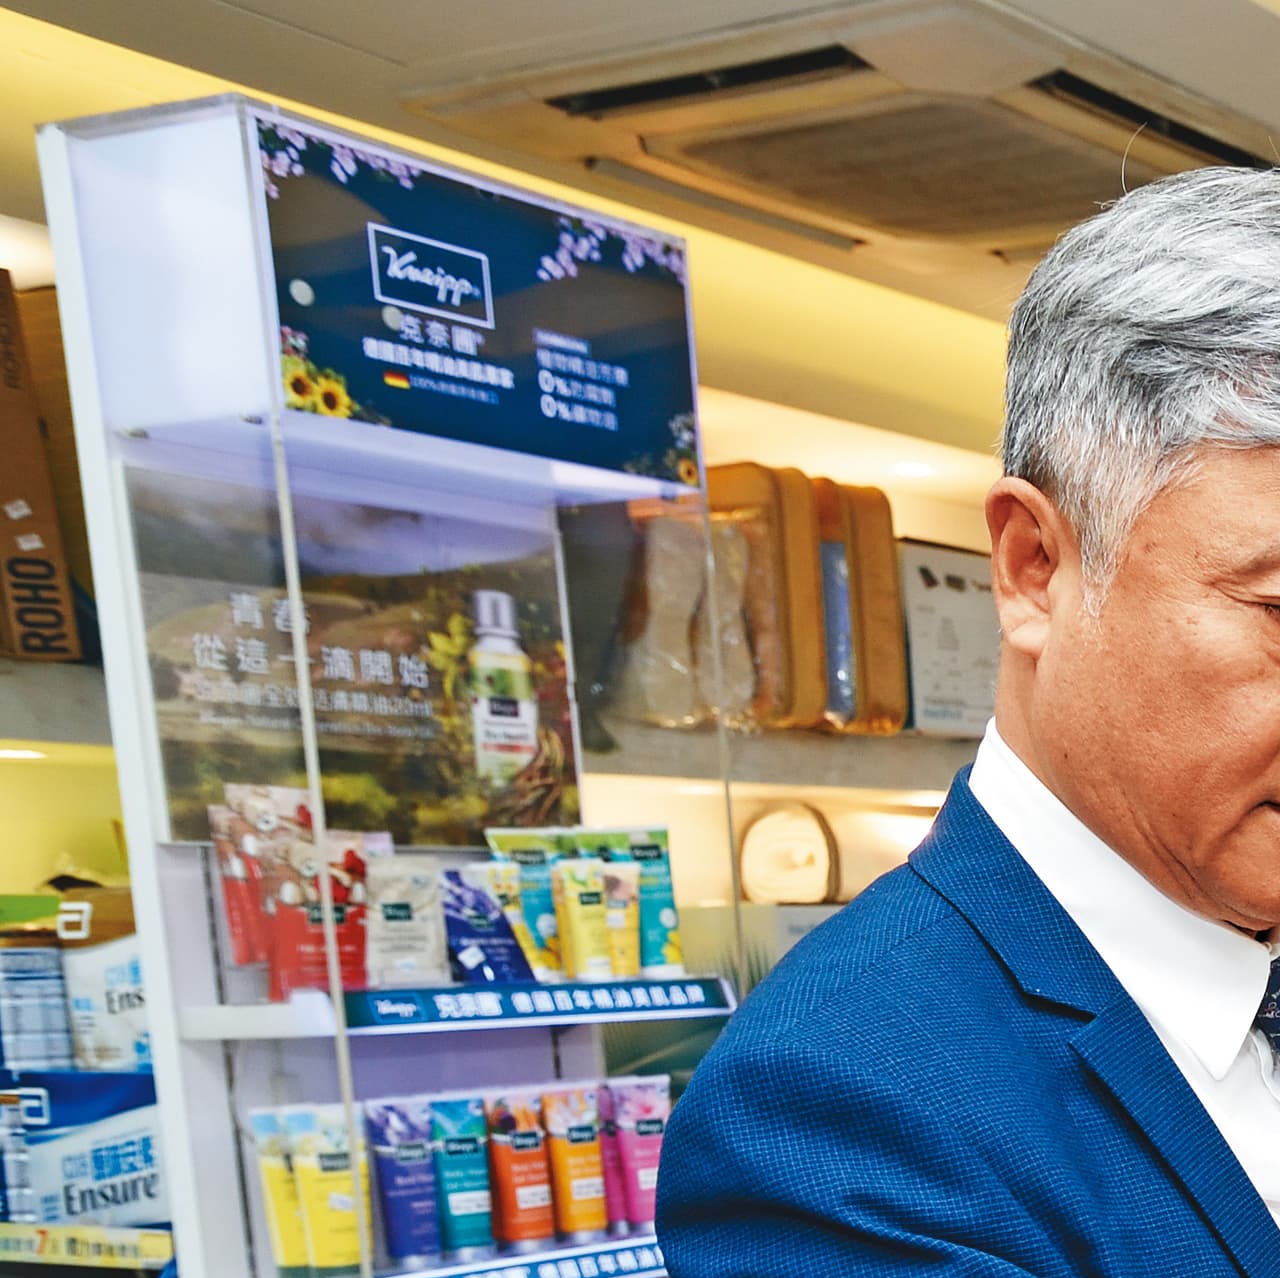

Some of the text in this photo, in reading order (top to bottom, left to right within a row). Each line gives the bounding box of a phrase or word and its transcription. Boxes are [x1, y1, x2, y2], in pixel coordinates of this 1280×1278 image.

[381, 245, 480, 306] Kneipp
[7, 556, 72, 656] ROHO
[64, 1173, 158, 1215] Ensure
